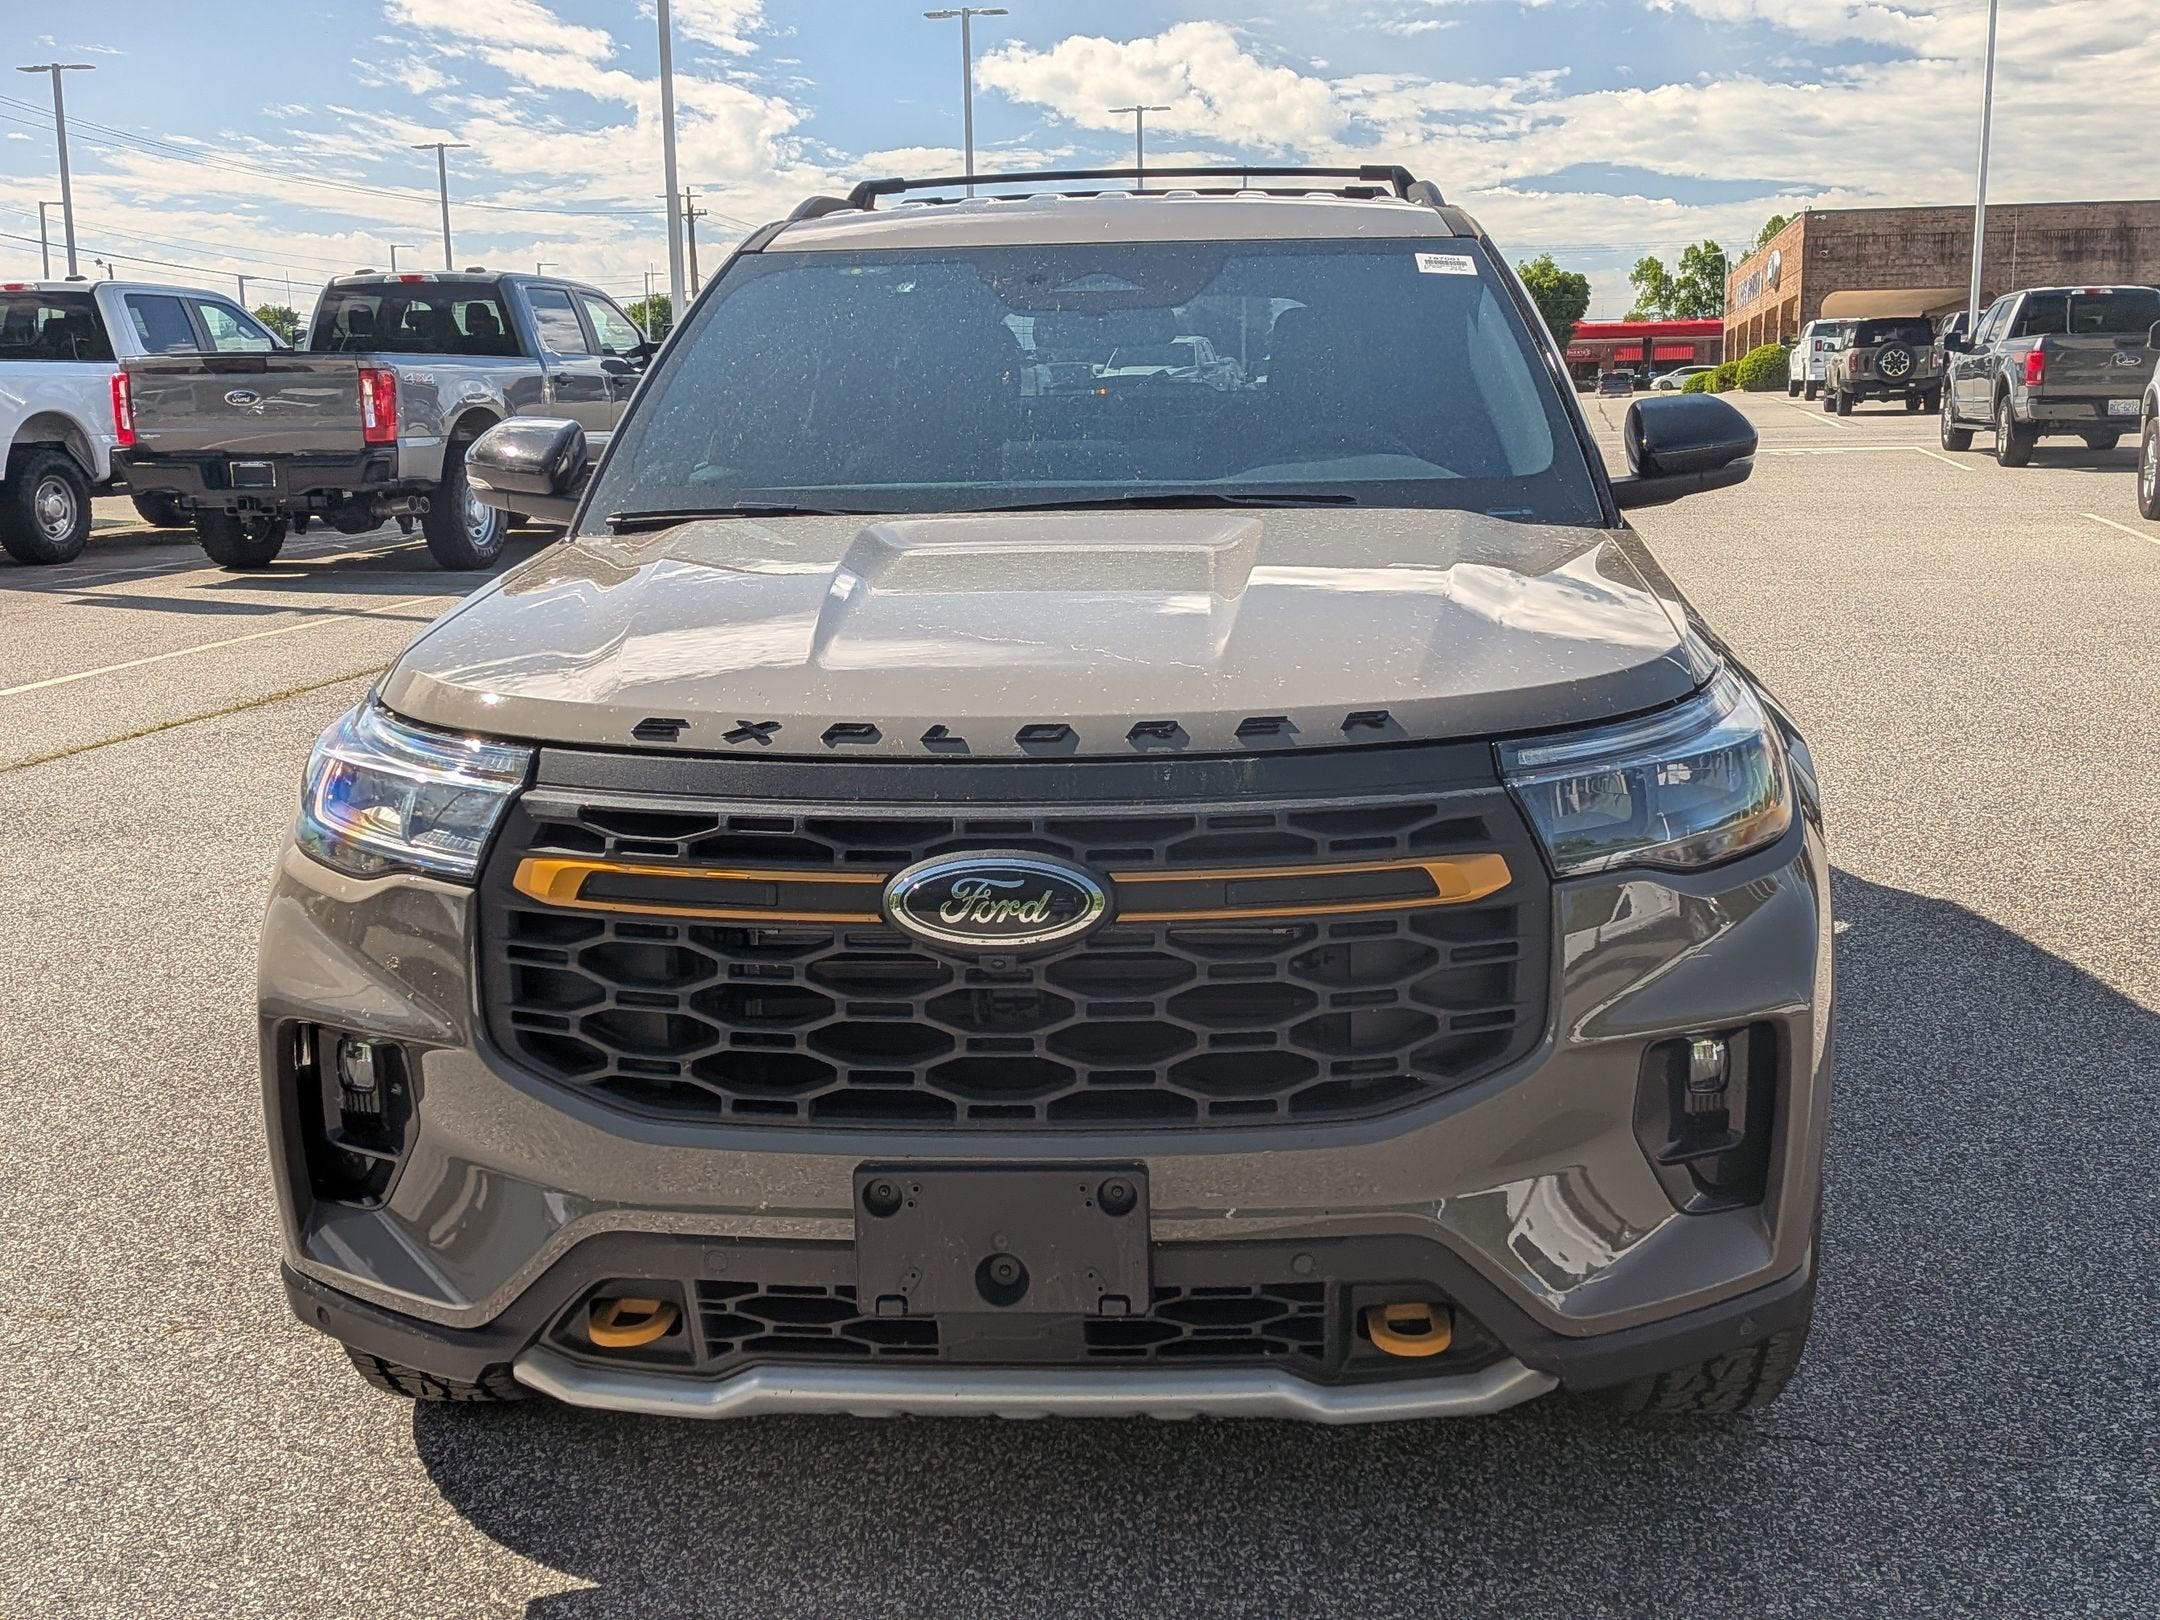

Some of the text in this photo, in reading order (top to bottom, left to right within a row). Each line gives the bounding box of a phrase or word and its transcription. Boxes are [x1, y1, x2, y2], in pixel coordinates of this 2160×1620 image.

[231, 393, 251, 403] Ford
[631, 710, 1399, 752] EXPLORER
[940, 877, 1053, 924] Ford
